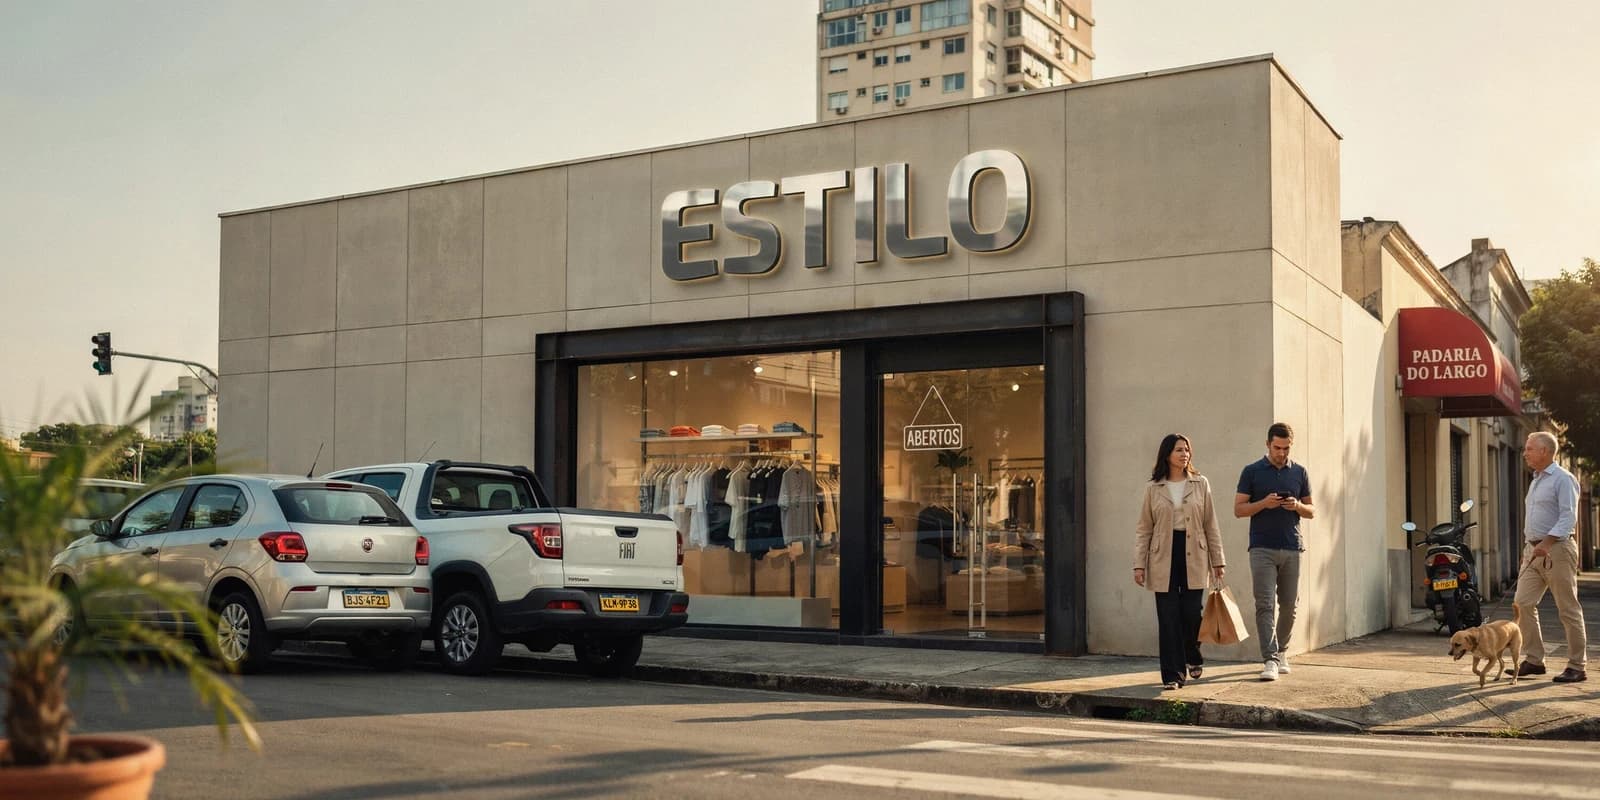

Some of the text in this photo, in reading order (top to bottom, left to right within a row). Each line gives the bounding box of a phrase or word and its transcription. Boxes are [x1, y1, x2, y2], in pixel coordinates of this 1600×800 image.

[661, 149, 1032, 282] ESTILO
[1412, 347, 1482, 363] PADARIA
[1407, 364, 1488, 380] DO LARGO
[907, 428, 960, 447] ABERTOS
[619, 542, 636, 559] FIAT
